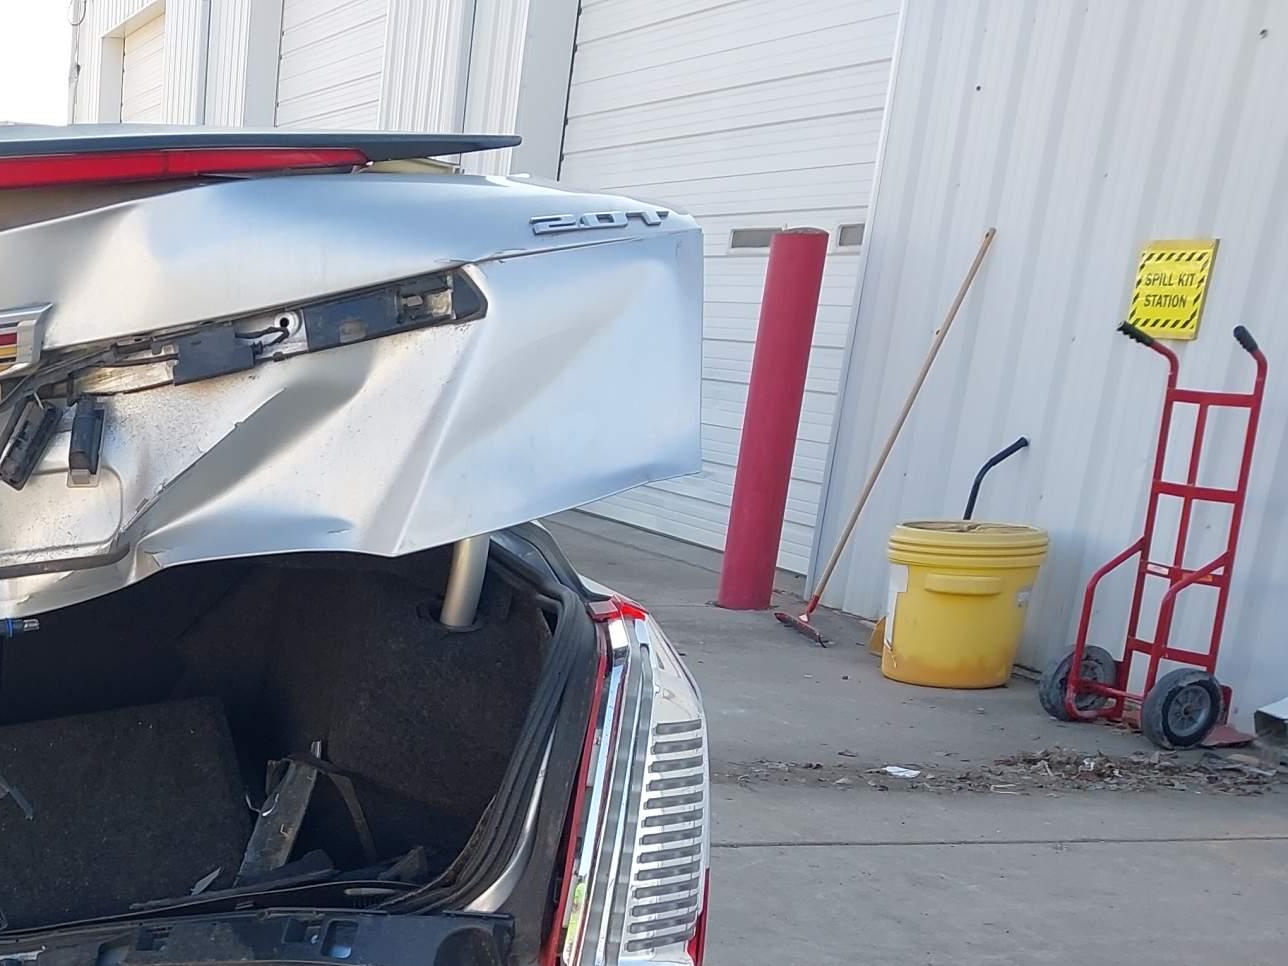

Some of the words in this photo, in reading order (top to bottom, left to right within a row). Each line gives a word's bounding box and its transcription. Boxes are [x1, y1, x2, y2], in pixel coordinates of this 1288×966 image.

[1145, 273, 1174, 286] SPILL
[1178, 273, 1196, 286] KIT
[1144, 295, 1187, 308] STATION
